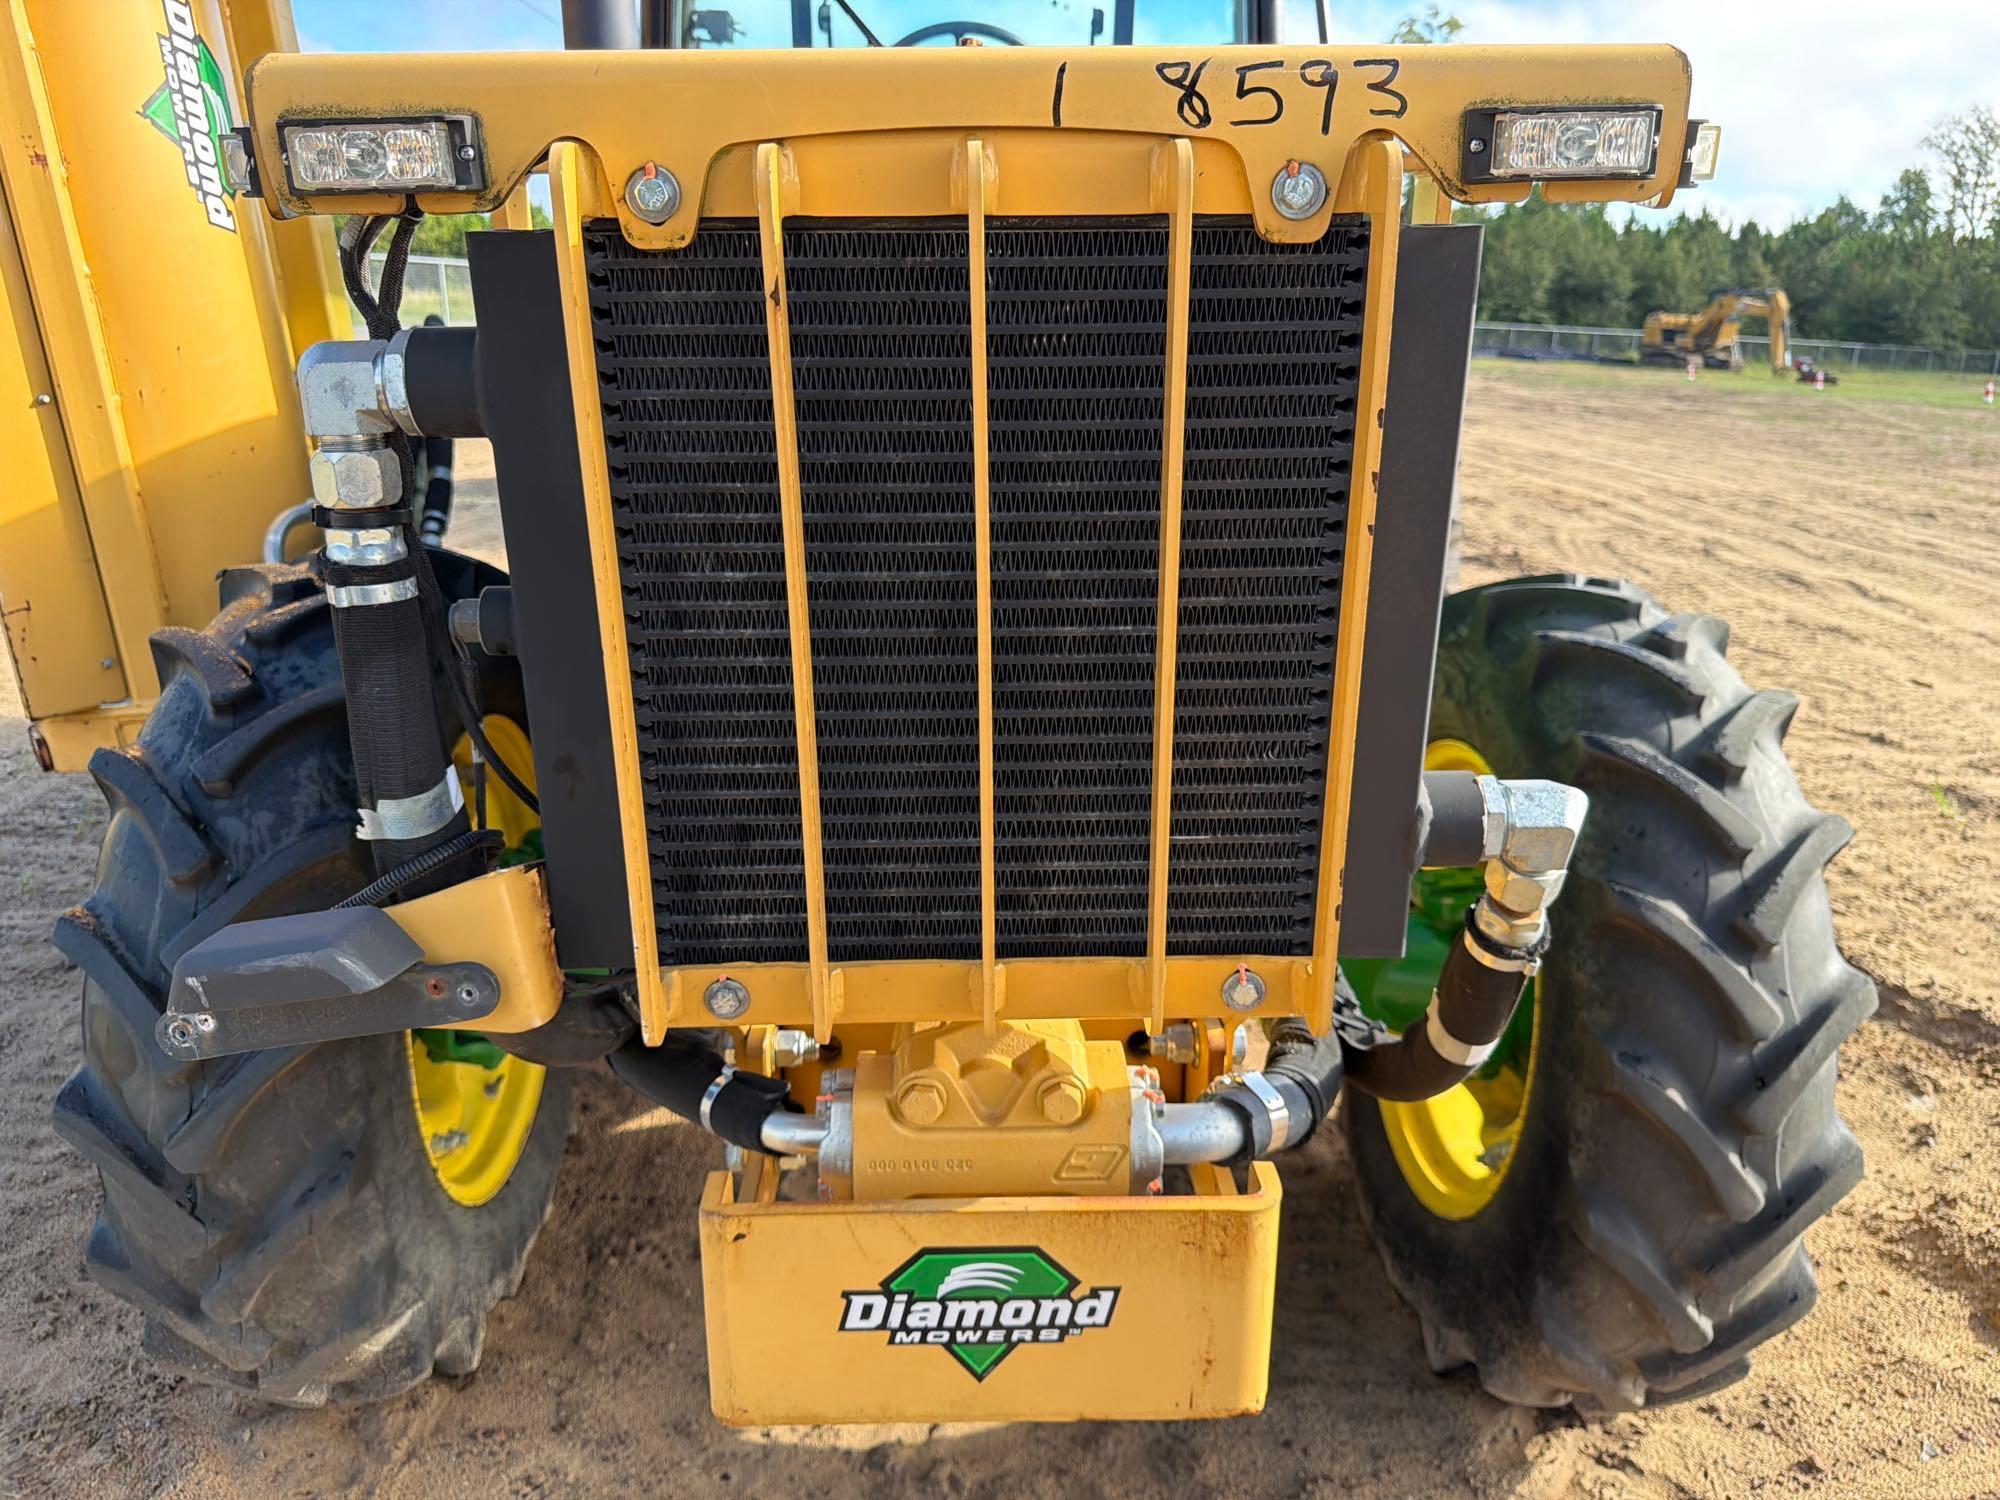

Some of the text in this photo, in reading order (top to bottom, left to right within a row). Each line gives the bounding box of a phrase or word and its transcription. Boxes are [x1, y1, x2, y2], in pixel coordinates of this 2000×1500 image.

[160, 38, 200, 186] MOWERS
[163, 0, 236, 232] Diamond
[1155, 56, 1408, 136] 8593
[844, 1290, 1115, 1330] Diamond
[893, 1329, 1061, 1344] MOWERS
